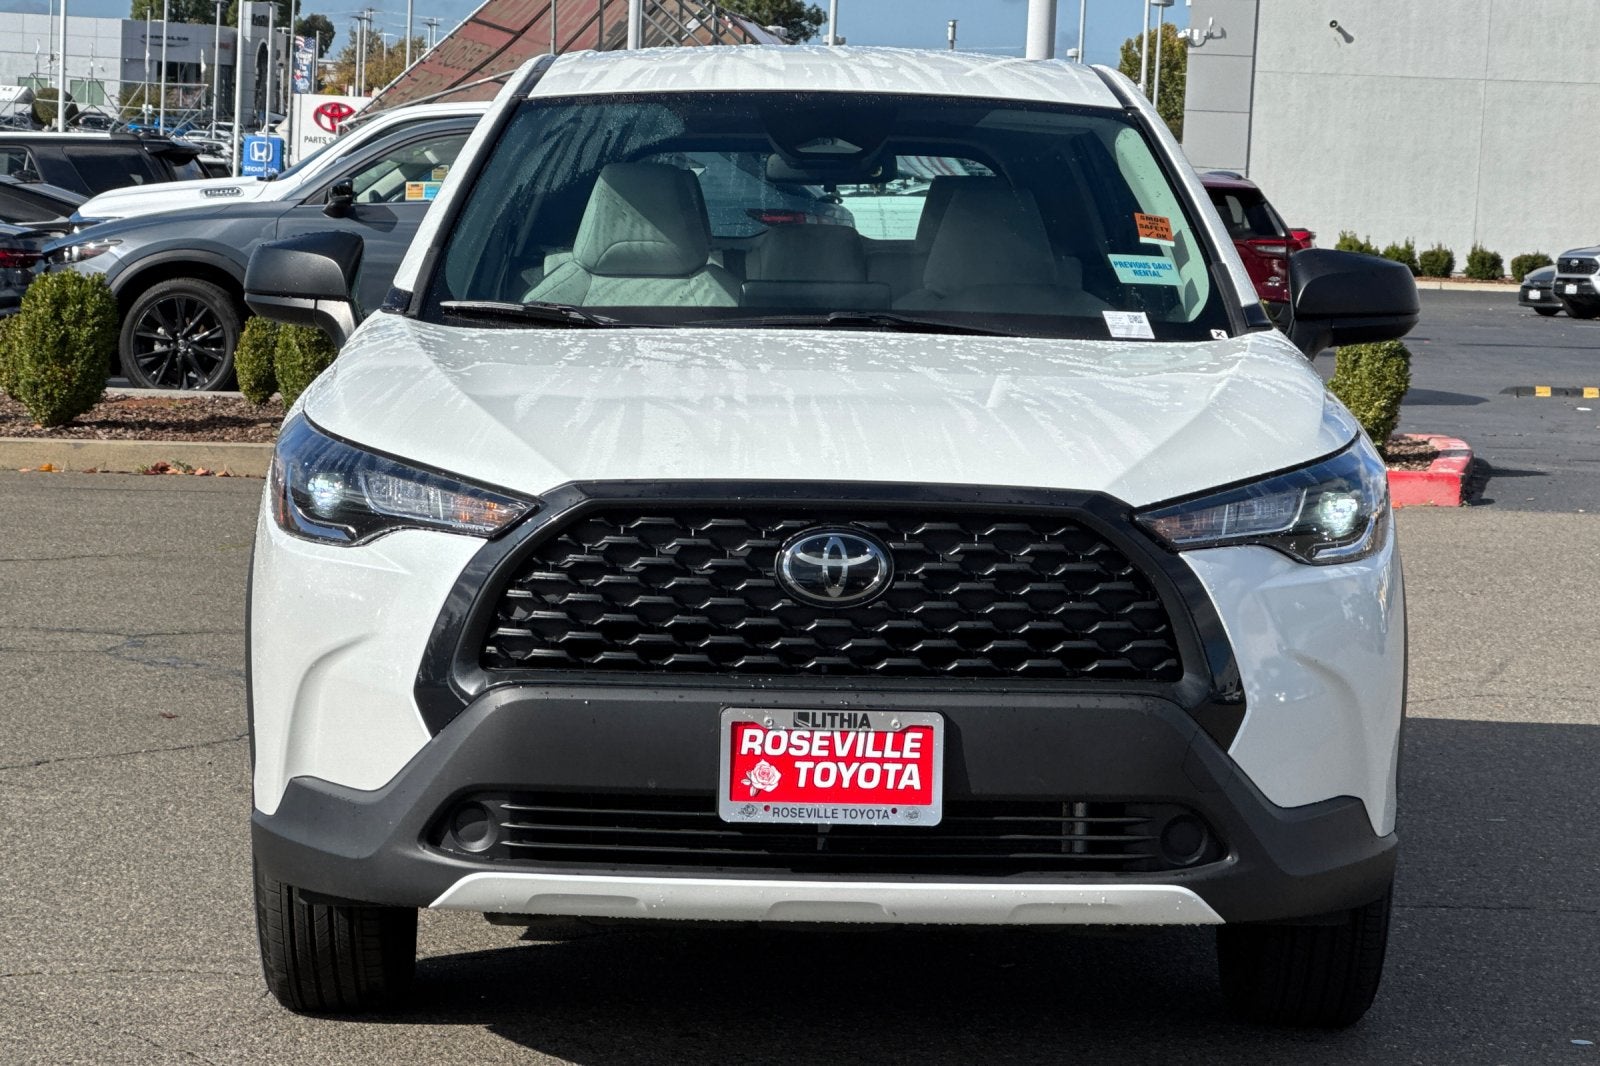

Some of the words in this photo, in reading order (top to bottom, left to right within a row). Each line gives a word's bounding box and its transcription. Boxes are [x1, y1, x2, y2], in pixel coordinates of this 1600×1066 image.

[304, 135, 327, 144] PARTS
[1140, 215, 1166, 223] SMOG
[1139, 223, 1169, 232] SAFETY
[1113, 261, 1152, 269] PREVIOUS
[811, 712, 872, 728] LITHIA
[740, 728, 924, 759] ROSEVILLE
[794, 761, 922, 790] TOYOTA
[772, 807, 839, 820] ROSEVILLE
[842, 808, 890, 820] TOYOTA
